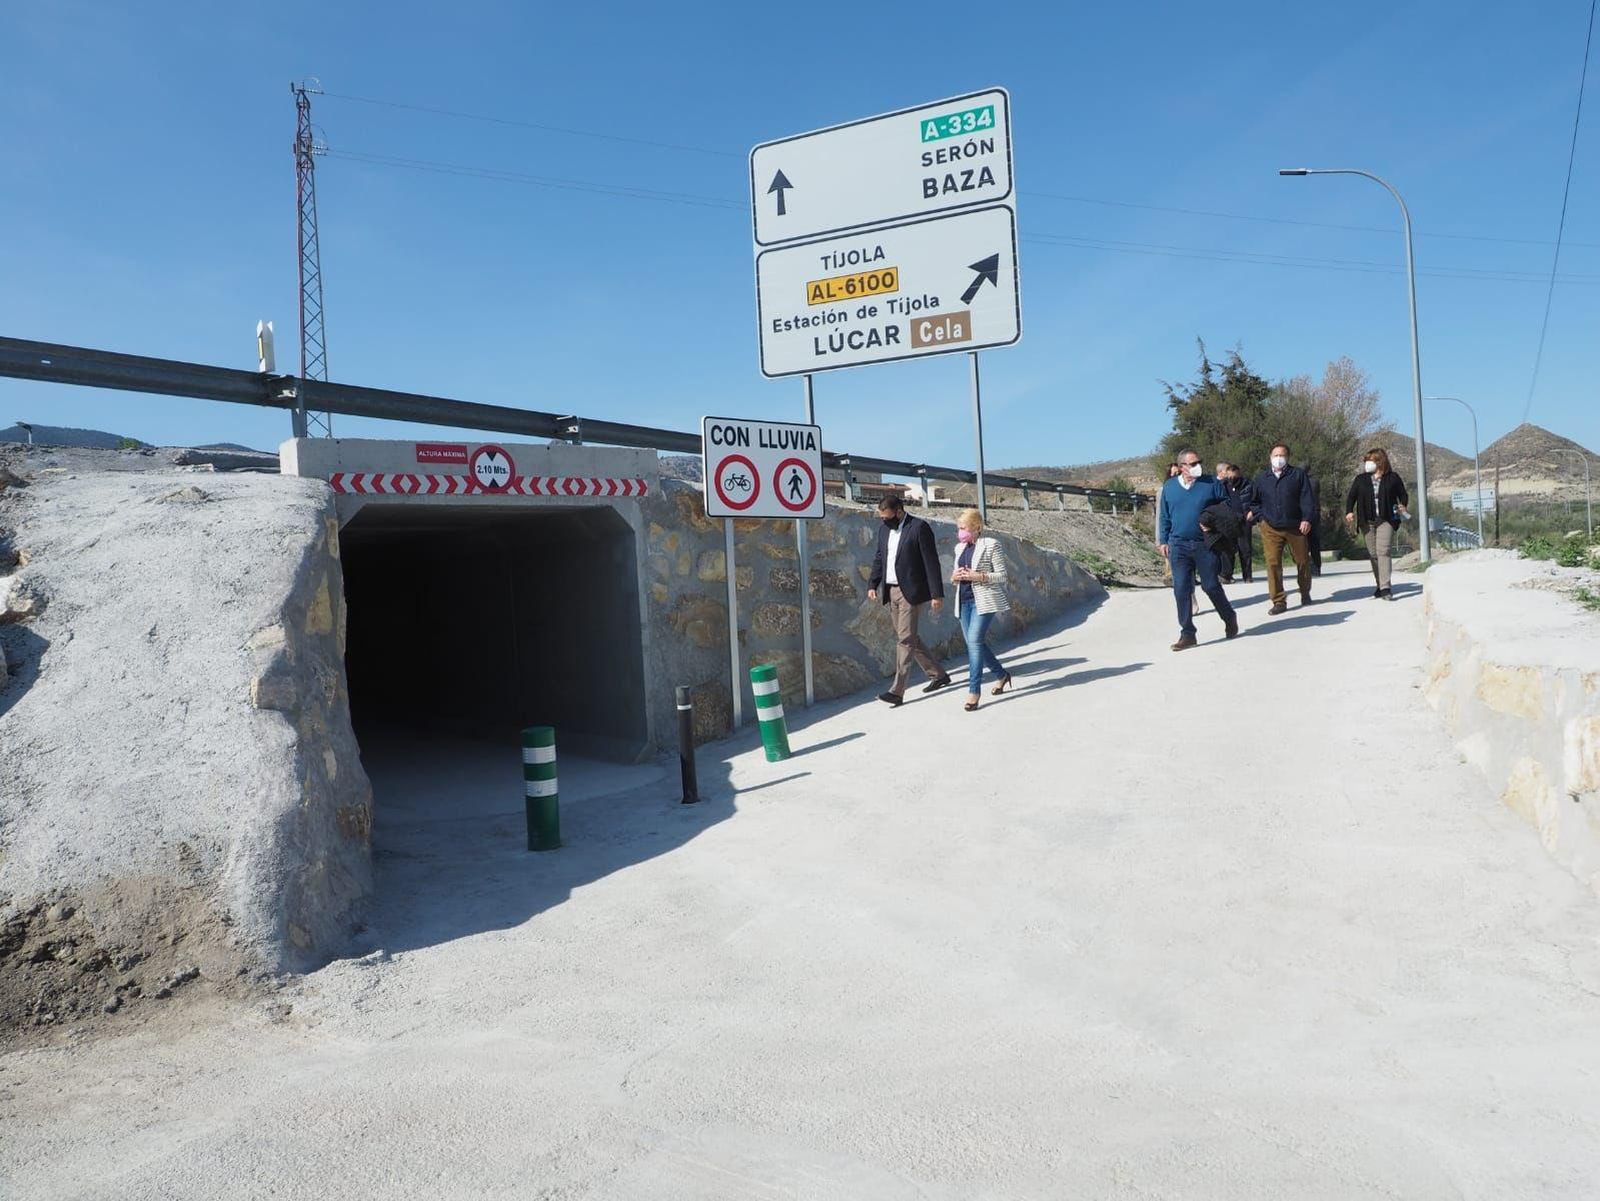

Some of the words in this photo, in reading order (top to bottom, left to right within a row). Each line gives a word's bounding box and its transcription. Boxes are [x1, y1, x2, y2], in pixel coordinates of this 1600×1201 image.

[924, 109, 992, 140] A-334
[921, 138, 995, 167] SERÓN
[923, 166, 996, 198] BAZA
[821, 245, 885, 271] TÍJOLA
[811, 272, 895, 301] AL-6100
[773, 309, 848, 333] Estación
[856, 304, 878, 319] de
[887, 294, 940, 315] Tíjola
[814, 324, 900, 356] LÚCAR
[919, 320, 963, 343] Cela
[711, 425, 750, 447] CON
[759, 428, 817, 451] LLUVIA
[477, 465, 492, 474] 2.10
